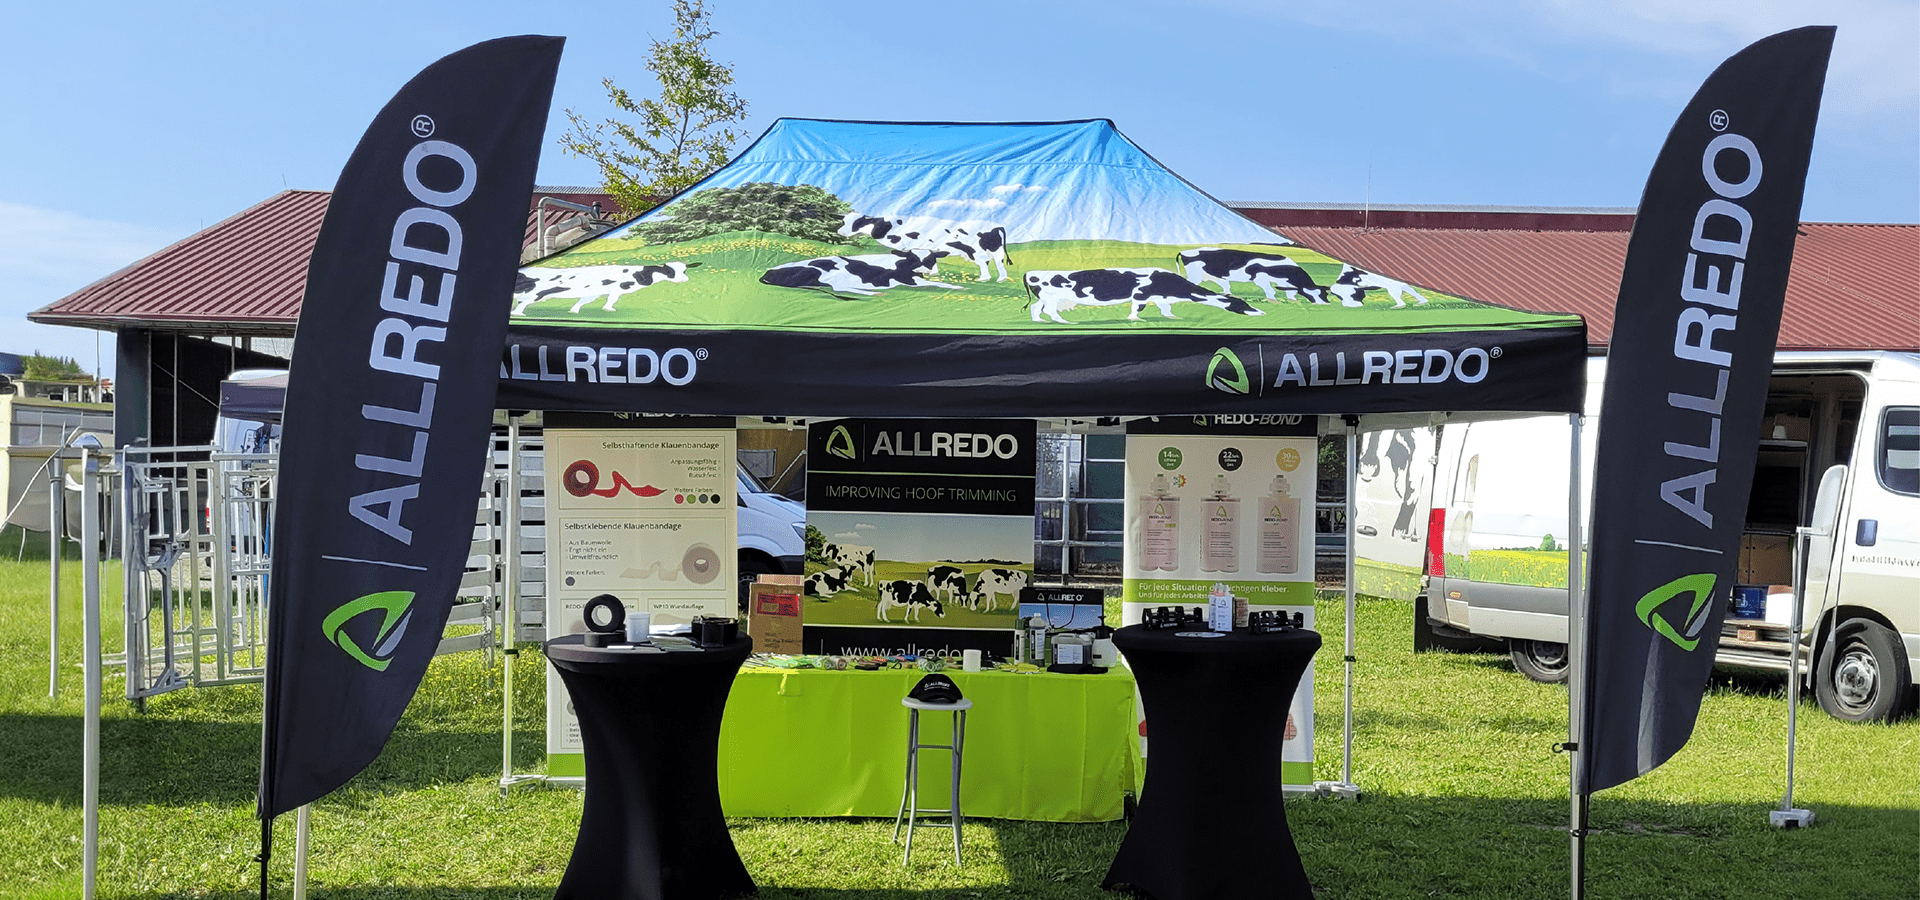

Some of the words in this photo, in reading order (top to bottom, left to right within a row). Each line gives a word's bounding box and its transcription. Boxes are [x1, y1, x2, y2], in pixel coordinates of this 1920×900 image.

[1214, 414, 1302, 425] REDO-BOND
[602, 441, 660, 449] Selbsthaftende
[660, 441, 720, 450] Klauenbandage
[871, 431, 1018, 460] ALLREDO
[825, 485, 900, 499] IMPROVING
[905, 487, 945, 500] HOOF
[948, 488, 1016, 502] TRIMMING
[564, 522, 622, 530] Selbstklebende
[623, 522, 682, 531] Klauenbandage
[1139, 582, 1152, 591] Für
[1153, 583, 1170, 592] jede
[1171, 583, 1207, 591] Situation
[1261, 585, 1289, 593] Kleber.
[1163, 592, 1181, 600] jedes
